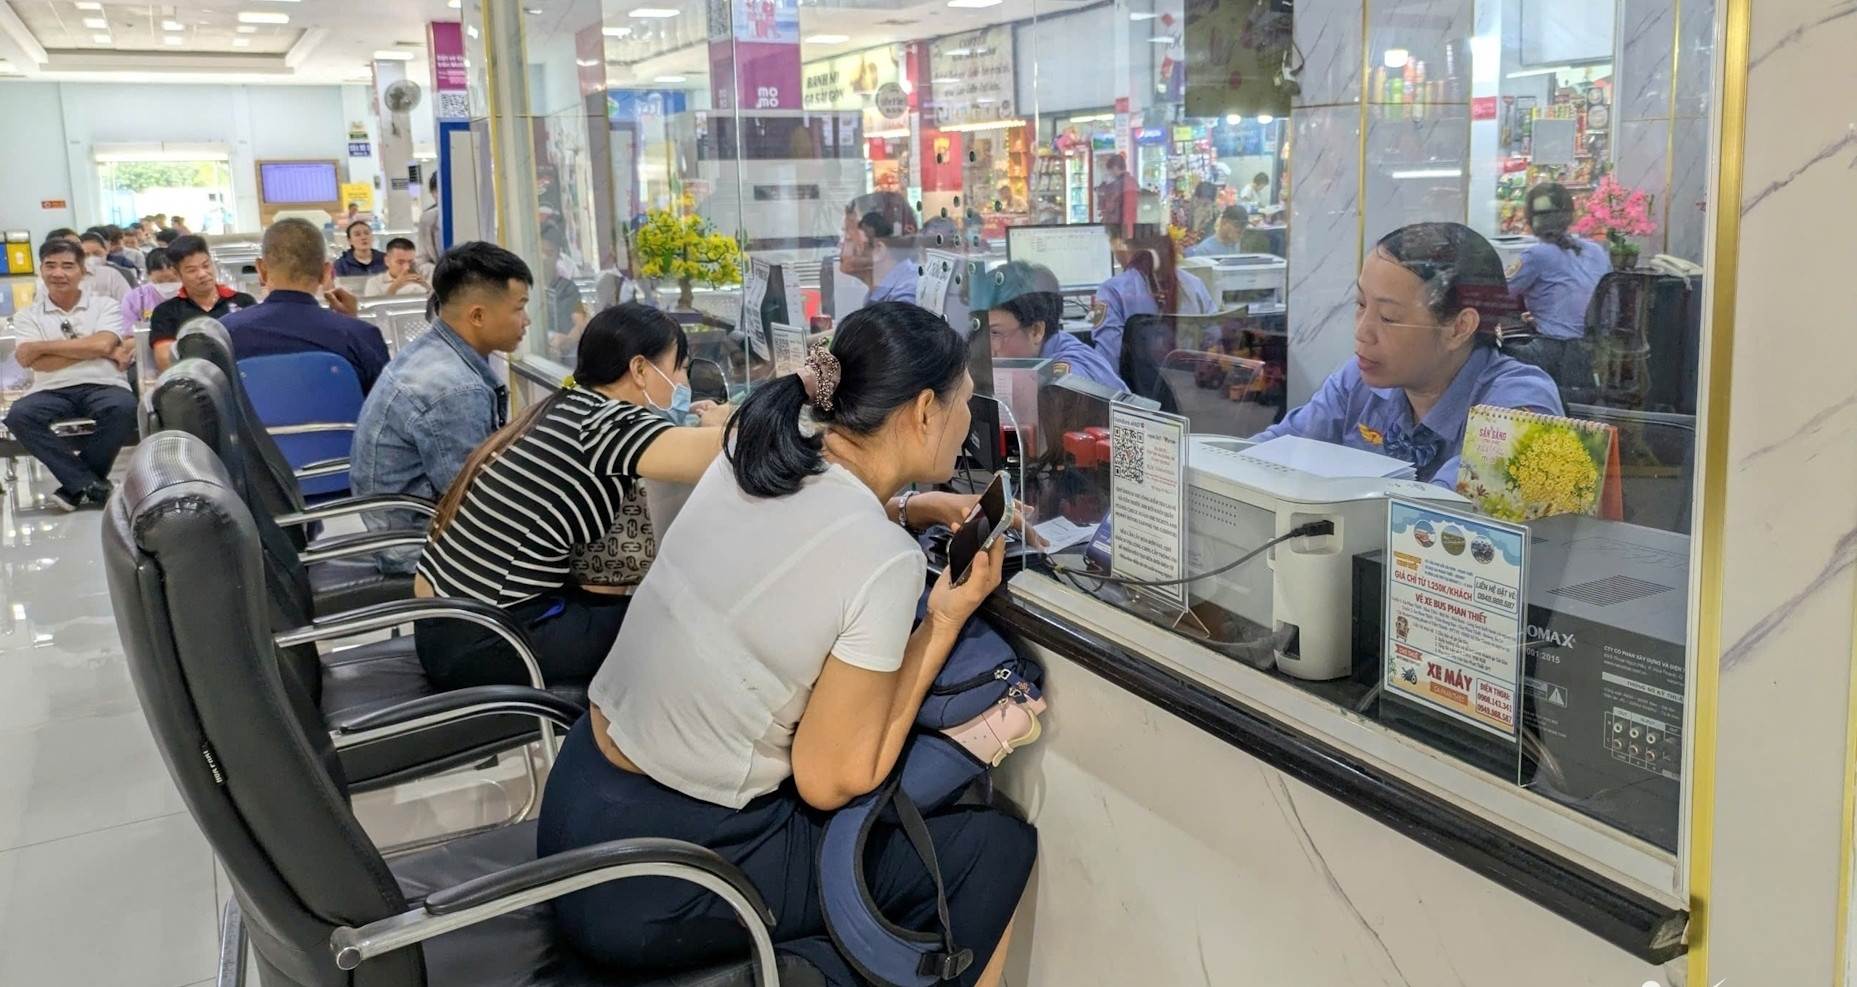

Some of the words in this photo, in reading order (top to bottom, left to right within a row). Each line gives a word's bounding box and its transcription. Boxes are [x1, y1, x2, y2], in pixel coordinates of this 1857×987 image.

[1395, 569, 1405, 579] GIÁ
[1415, 592, 1423, 602] VÉ
[1425, 597, 1432, 605] XE
[1434, 600, 1446, 610] BUS
[1447, 604, 1466, 617] PHAN
[1468, 608, 1487, 624] THIẾT
[1527, 624, 1574, 649] OMAX
[1526, 647, 1560, 664] 001:2015
[1427, 662, 1441, 680] XE
[1444, 668, 1472, 691] MÁY
[1480, 682, 1492, 694] ĐIỆN
